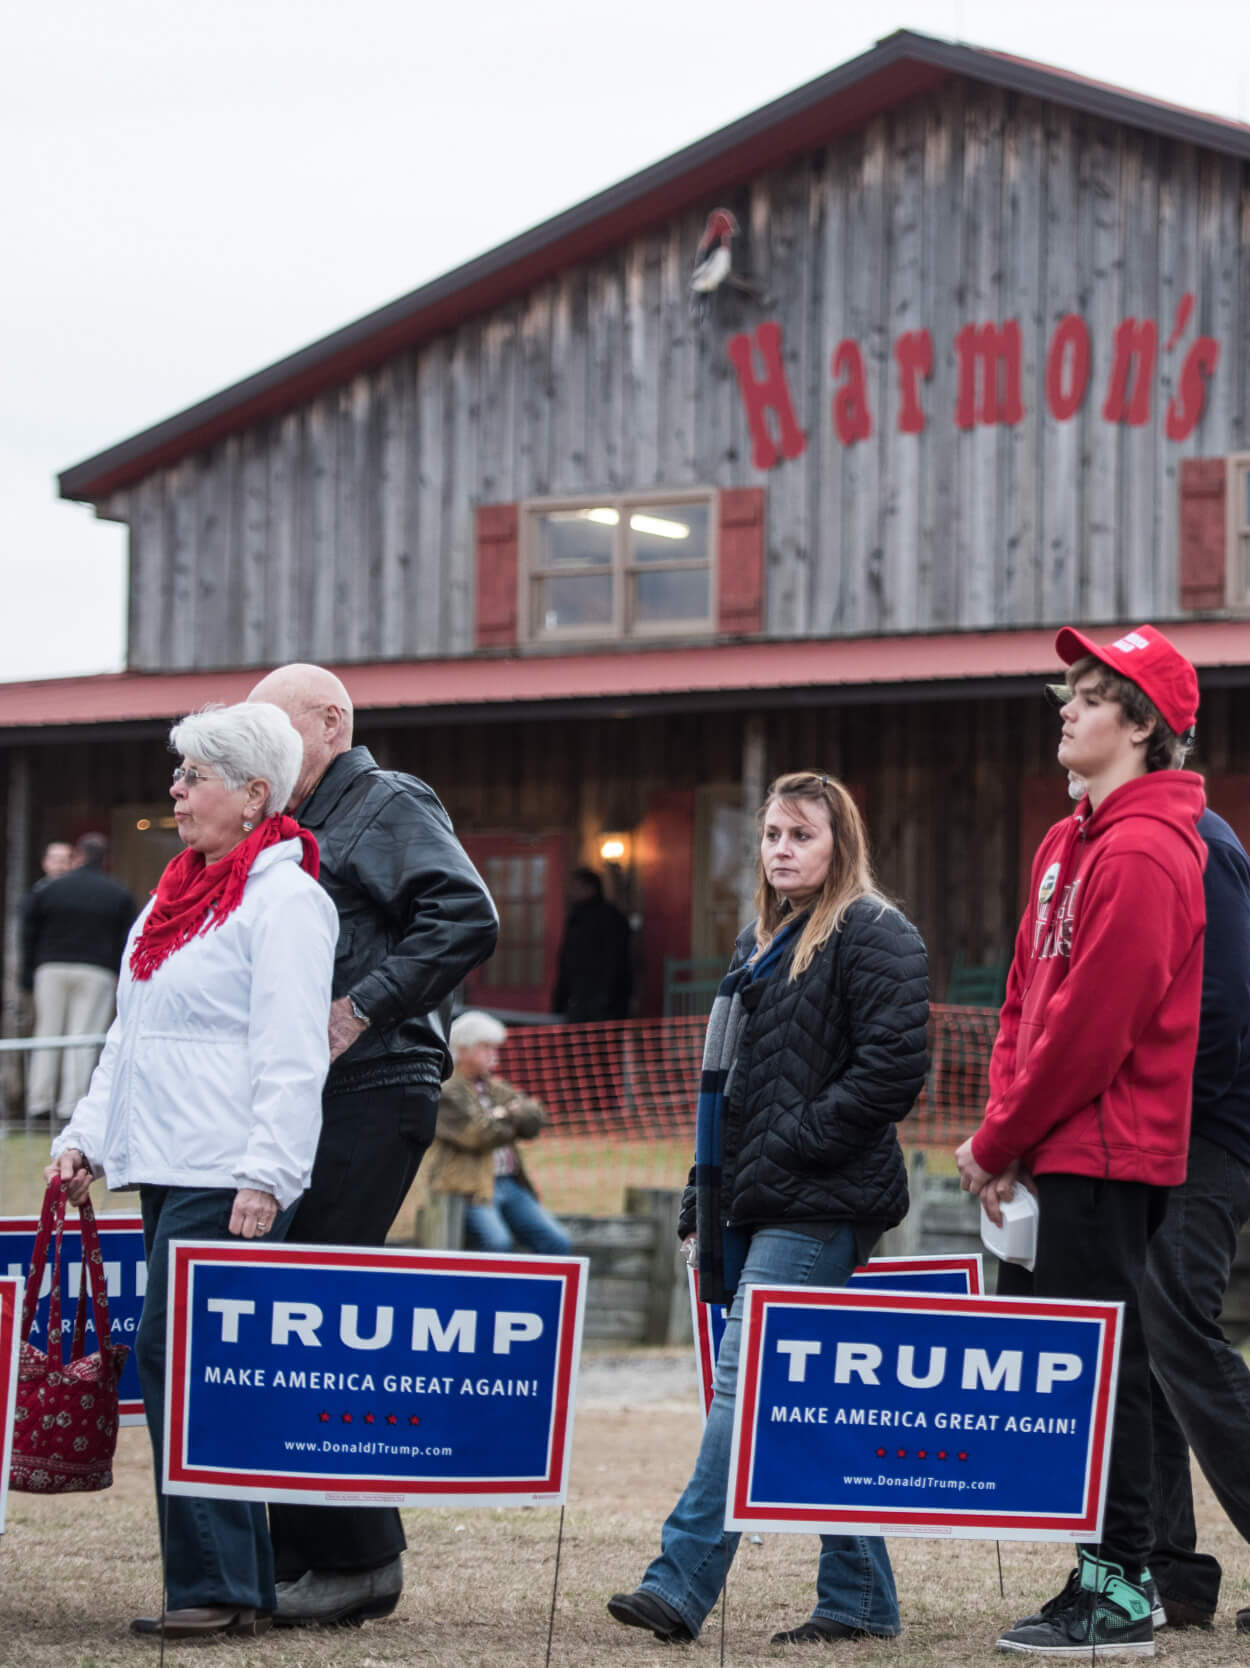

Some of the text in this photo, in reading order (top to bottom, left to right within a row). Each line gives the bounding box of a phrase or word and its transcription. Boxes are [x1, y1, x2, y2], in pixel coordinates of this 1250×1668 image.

[727, 292, 1219, 470] Harmon's
[207, 1298, 544, 1355] TRUMP
[204, 1366, 538, 1397] MAKE AMERICA GREAT AGAIN!
[776, 1339, 1083, 1394] TRUMP
[771, 1406, 1076, 1435] MAKE AMERICA GREAT AGAIN!
[285, 1441, 452, 1458] www.DonaldJTrump.com
[843, 1474, 996, 1492] www.DonaldJTrump.com
